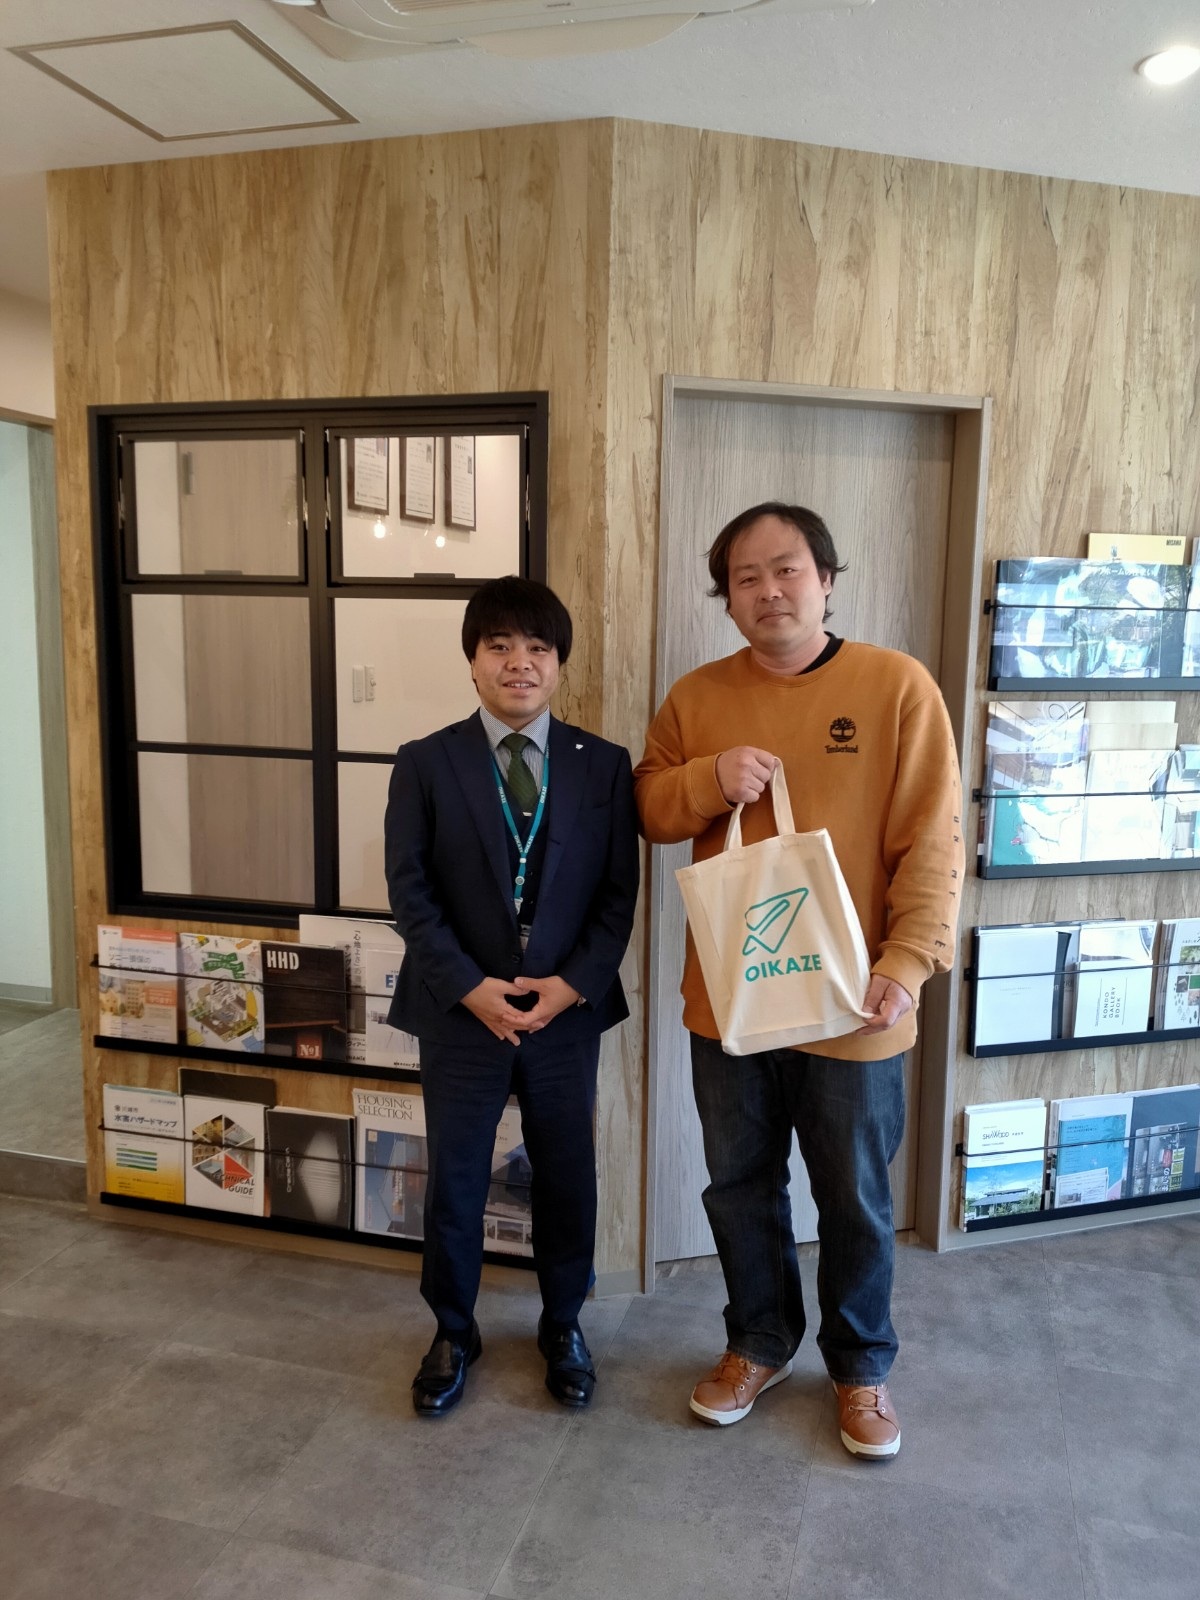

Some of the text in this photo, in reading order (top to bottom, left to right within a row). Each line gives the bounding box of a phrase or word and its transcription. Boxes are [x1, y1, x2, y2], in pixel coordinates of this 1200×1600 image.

[266, 950, 300, 970] HHD
[745, 953, 823, 983] OIKAZE
[1102, 991, 1110, 1019] KONDO
[1108, 986, 1116, 1019] GALLERY
[356, 1094, 413, 1110] HOUSING
[357, 1104, 413, 1121] SELECTION
[228, 1185, 254, 1196] GUIDE
